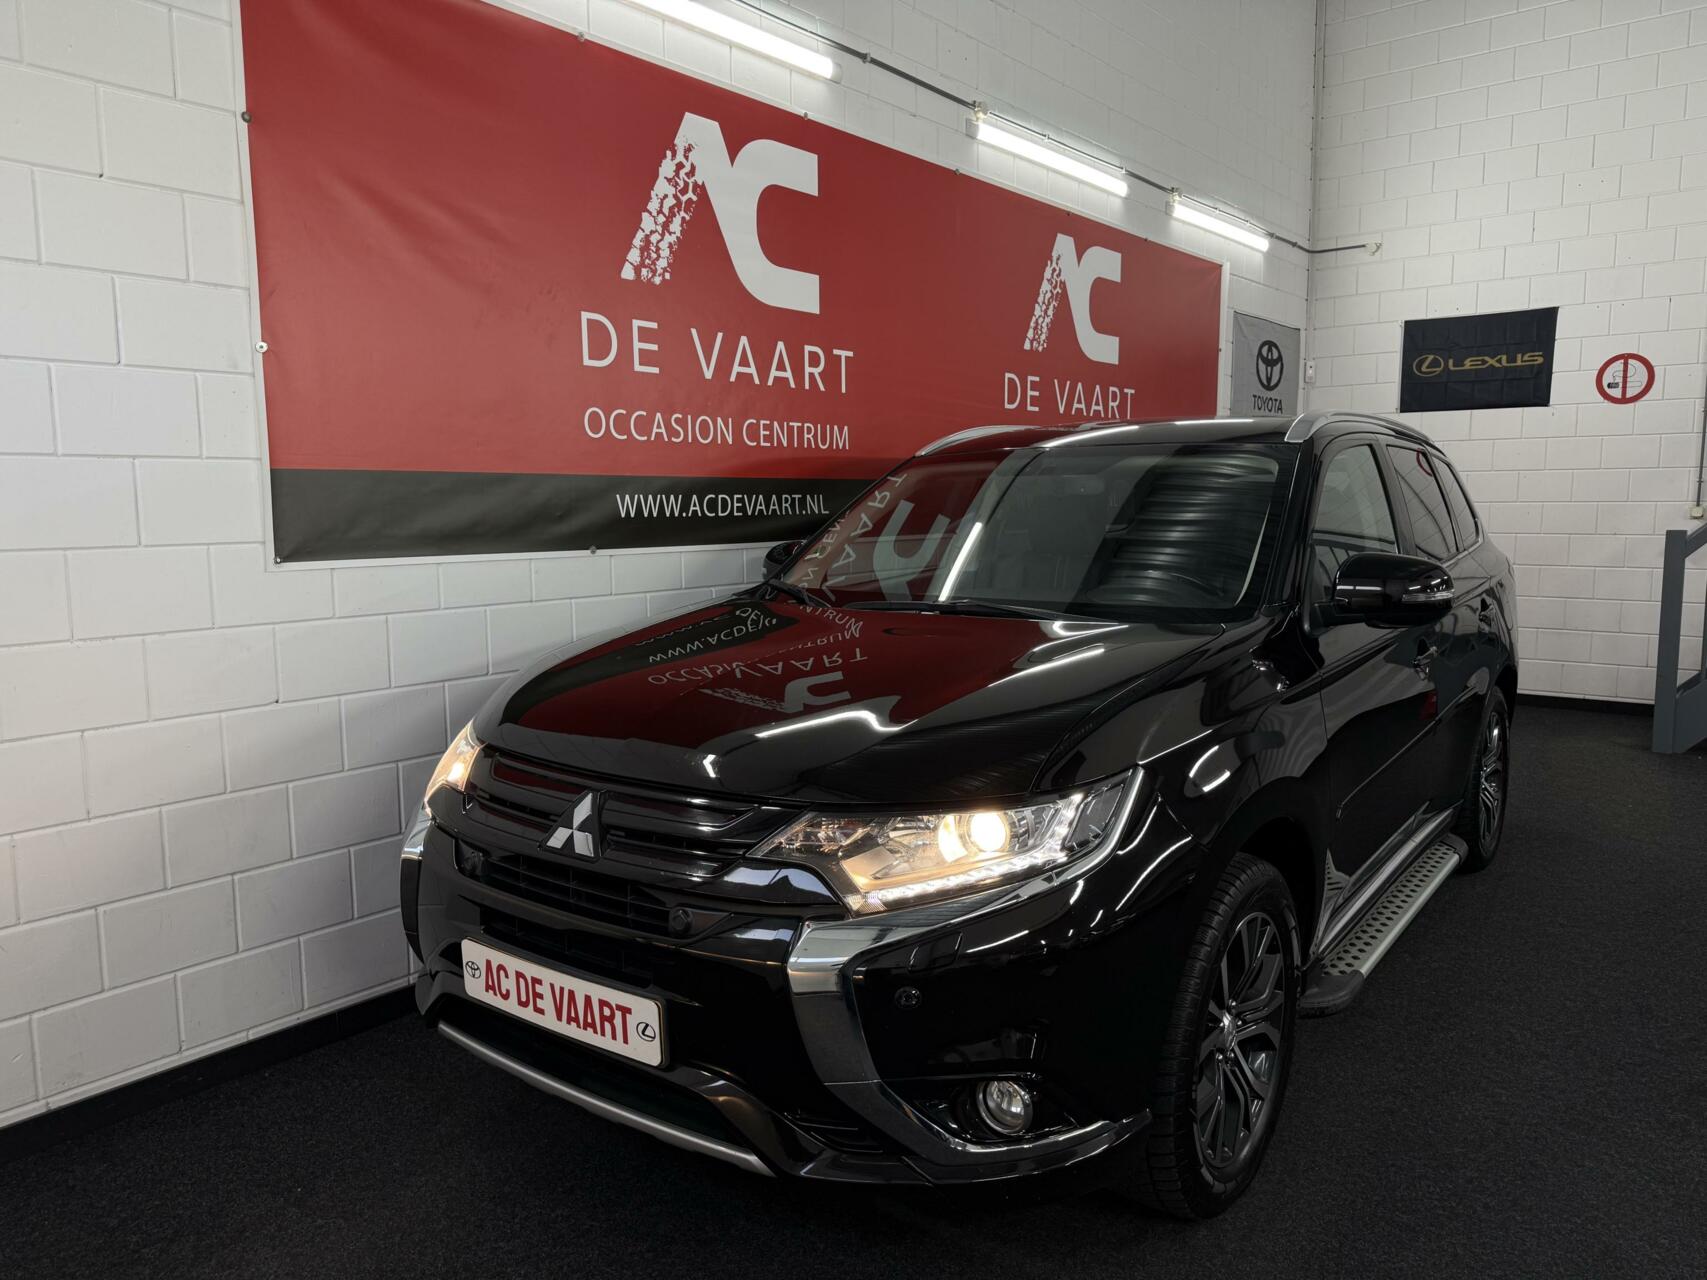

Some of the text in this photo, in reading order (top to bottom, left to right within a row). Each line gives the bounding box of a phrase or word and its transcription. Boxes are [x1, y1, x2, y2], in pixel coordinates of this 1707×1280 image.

[580, 310, 854, 394] DE VAART
[1448, 351, 1544, 371] LEXUS
[1003, 372, 1135, 419] DE VAART
[1252, 394, 1283, 415] TOYOTA
[583, 406, 850, 450] OCCASION CENTRUM
[616, 493, 829, 519] WWW.ACDEVAART.NL
[484, 958, 633, 1046] AC DE VAART
